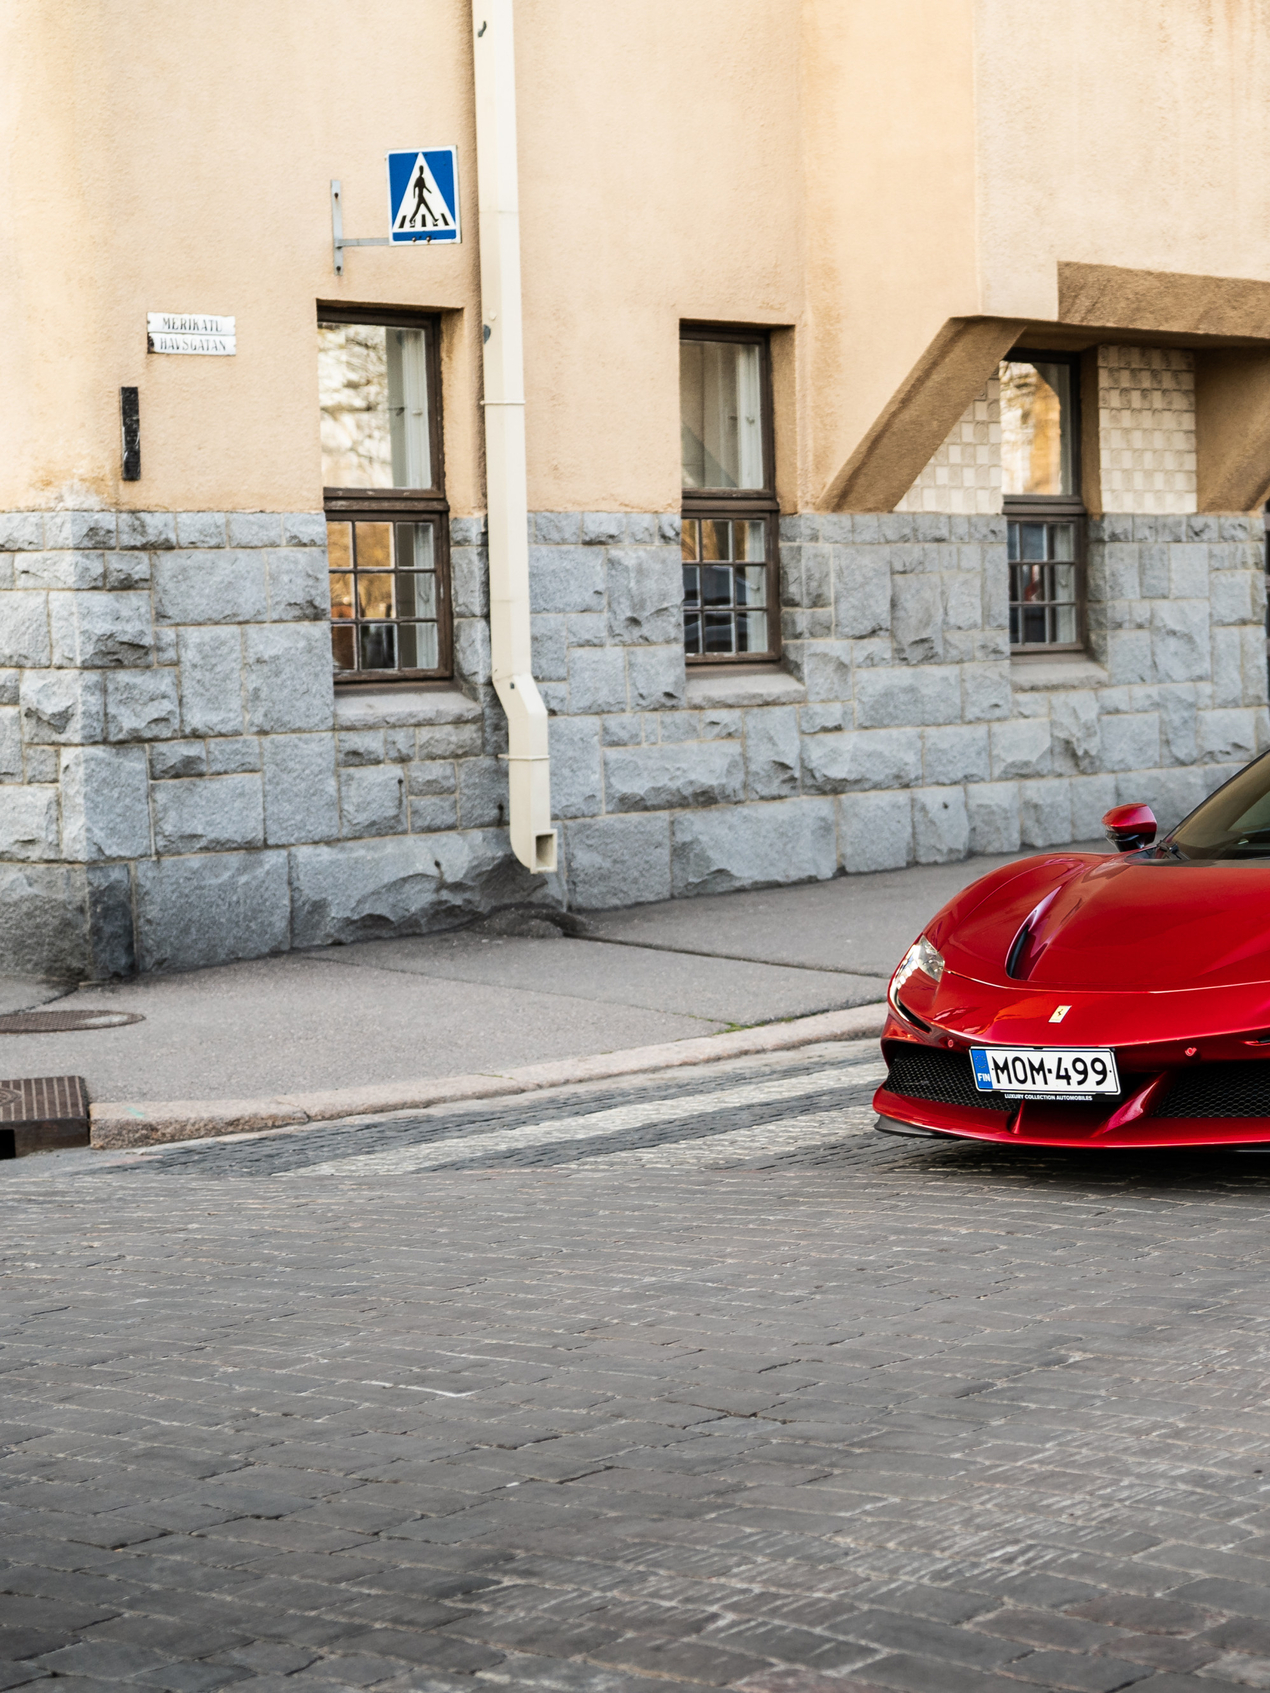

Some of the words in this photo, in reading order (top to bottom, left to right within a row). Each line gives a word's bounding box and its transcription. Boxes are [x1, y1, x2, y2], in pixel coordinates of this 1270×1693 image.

[162, 317, 222, 333] MERIKATU
[160, 337, 226, 352] HAVSGATAN
[977, 1073, 991, 1082] FIN
[992, 1056, 1108, 1086] MOM-499
[1024, 1093, 1055, 1101] COLLECTION
